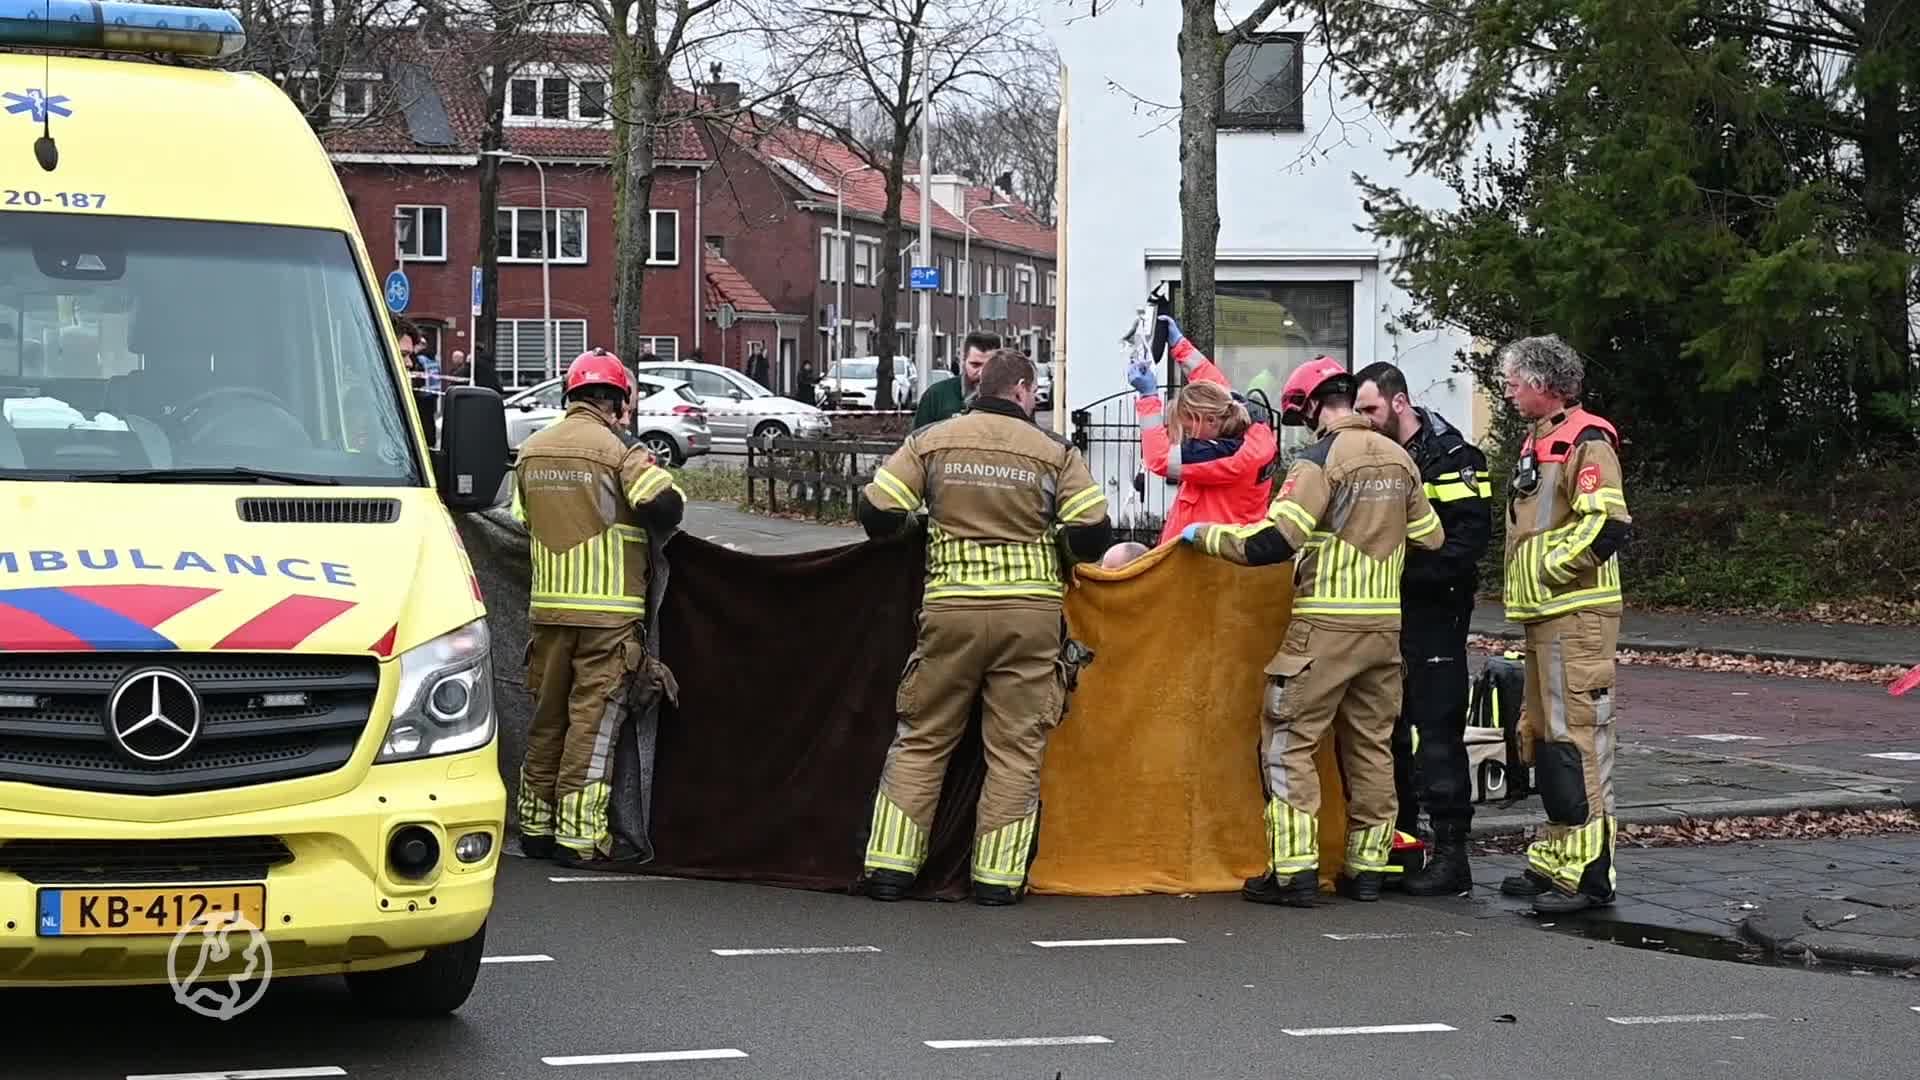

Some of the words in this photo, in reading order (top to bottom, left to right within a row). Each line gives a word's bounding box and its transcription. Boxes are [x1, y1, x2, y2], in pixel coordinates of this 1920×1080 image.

[4, 190, 106, 208] 20-187
[944, 463, 1036, 483] BRANDWEER
[41, 915, 57, 928] NL
